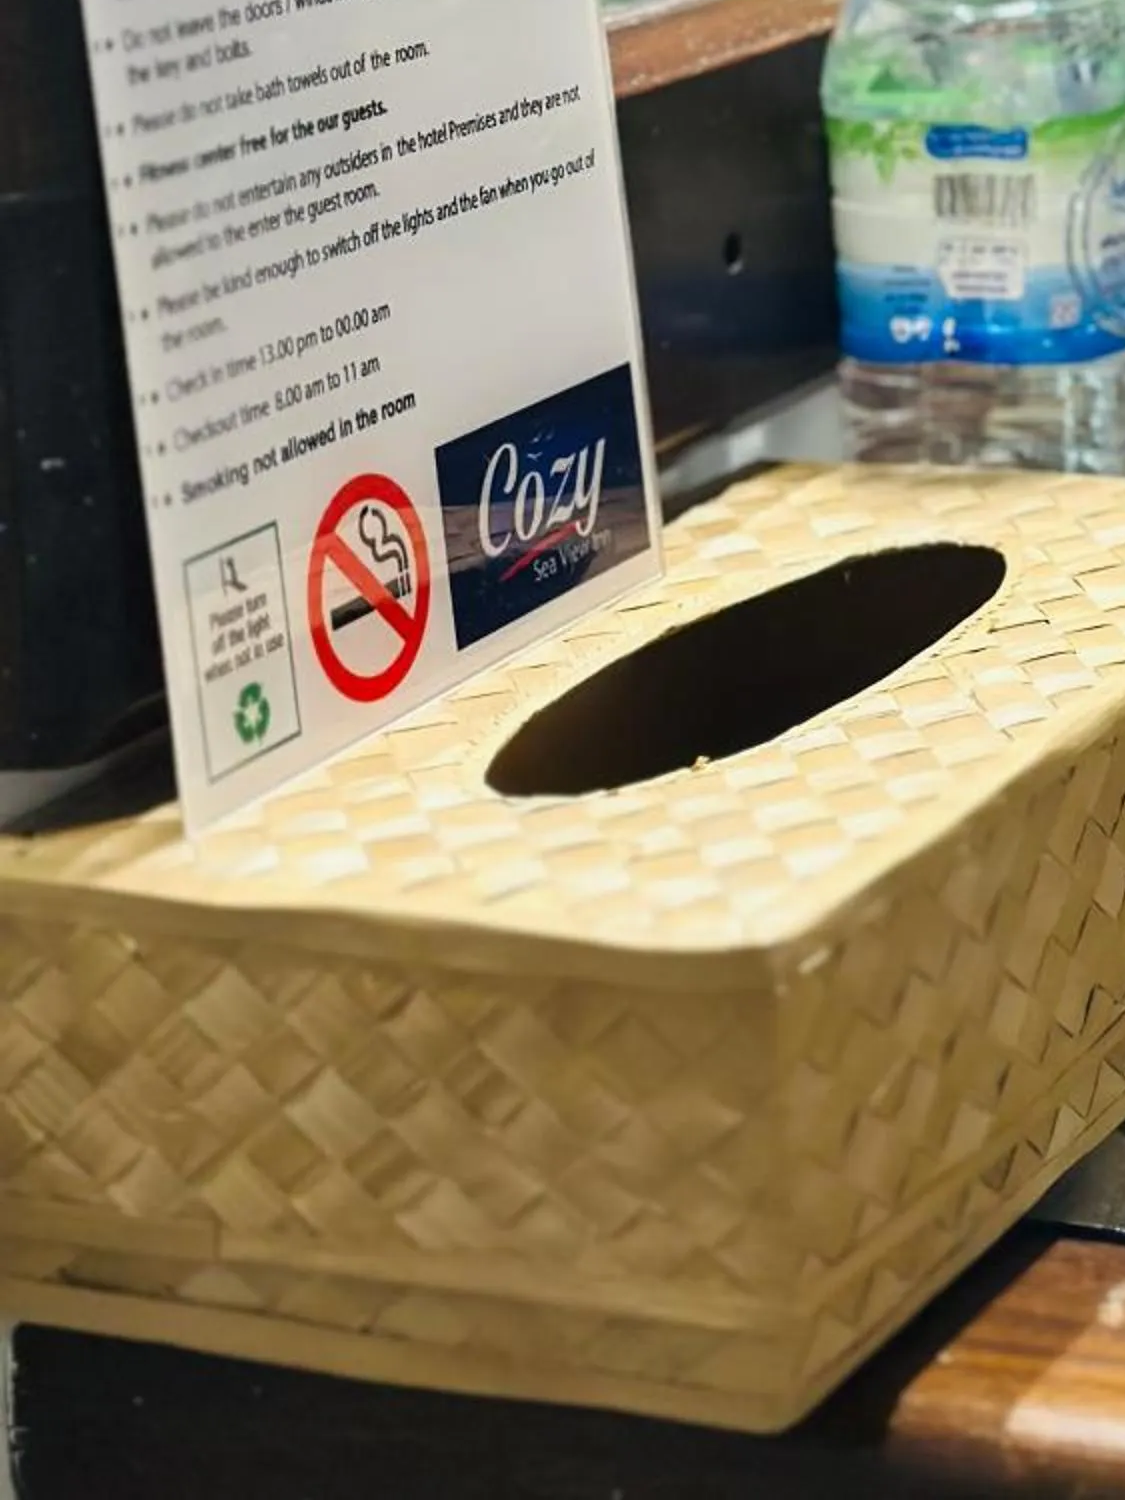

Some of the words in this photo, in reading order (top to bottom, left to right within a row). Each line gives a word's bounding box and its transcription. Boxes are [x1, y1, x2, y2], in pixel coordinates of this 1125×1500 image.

[218, 6, 241, 30] the
[185, 49, 211, 71] and
[225, 85, 254, 110] take
[256, 78, 286, 101] bath
[288, 65, 328, 93] towels
[330, 59, 351, 81] out
[353, 52, 365, 74] of
[369, 49, 391, 70] the
[395, 41, 429, 62] room.
[213, 193, 235, 212] not
[238, 174, 297, 205] entertain
[299, 169, 321, 188] any
[323, 150, 379, 180] outsiders
[381, 143, 393, 161] in
[397, 137, 416, 156] the
[418, 123, 447, 149] hotel
[448, 112, 497, 140] Premises
[499, 101, 518, 124] and
[518, 98, 543, 117] they
[545, 96, 560, 110] are
[562, 86, 580, 104] not
[240, 133, 267, 156] free
[270, 125, 289, 146] for
[291, 117, 314, 140] the
[316, 112, 339, 132] our
[342, 99, 387, 131] guests.
[222, 266, 252, 294] kind
[255, 253, 304, 284] enough
[306, 248, 320, 266] to
[321, 229, 361, 261] switch
[363, 221, 380, 247] off
[381, 218, 401, 241] the
[401, 207, 434, 237] lights
[436, 196, 458, 220] and
[459, 192, 478, 212] the
[479, 186, 498, 207] fan
[499, 176, 528, 199] when
[529, 170, 549, 194] you
[550, 164, 565, 186] go
[566, 158, 584, 176] out
[585, 148, 595, 168] of
[223, 224, 245, 246] the
[247, 213, 281, 239] enter
[284, 204, 305, 226] the
[307, 191, 341, 224] guest
[343, 182, 380, 206] room.
[166, 371, 207, 402] Check
[226, 354, 256, 379] time
[259, 336, 294, 366] 13.00
[296, 331, 318, 360] pm
[320, 324, 334, 344] to
[335, 308, 369, 338] 00.00
[371, 304, 391, 324] am
[239, 399, 270, 426] time
[274, 385, 302, 412] 8.00
[304, 379, 325, 400] am
[327, 370, 341, 390] to
[343, 360, 357, 382] 11
[360, 356, 380, 376] am
[180, 469, 249, 504] Smoking
[252, 448, 278, 474] not
[280, 420, 336, 463] allowed
[339, 416, 353, 437] in
[355, 409, 378, 430] the
[380, 392, 416, 420] room
[479, 438, 606, 557] Cozy
[533, 558, 557, 581] Sea
